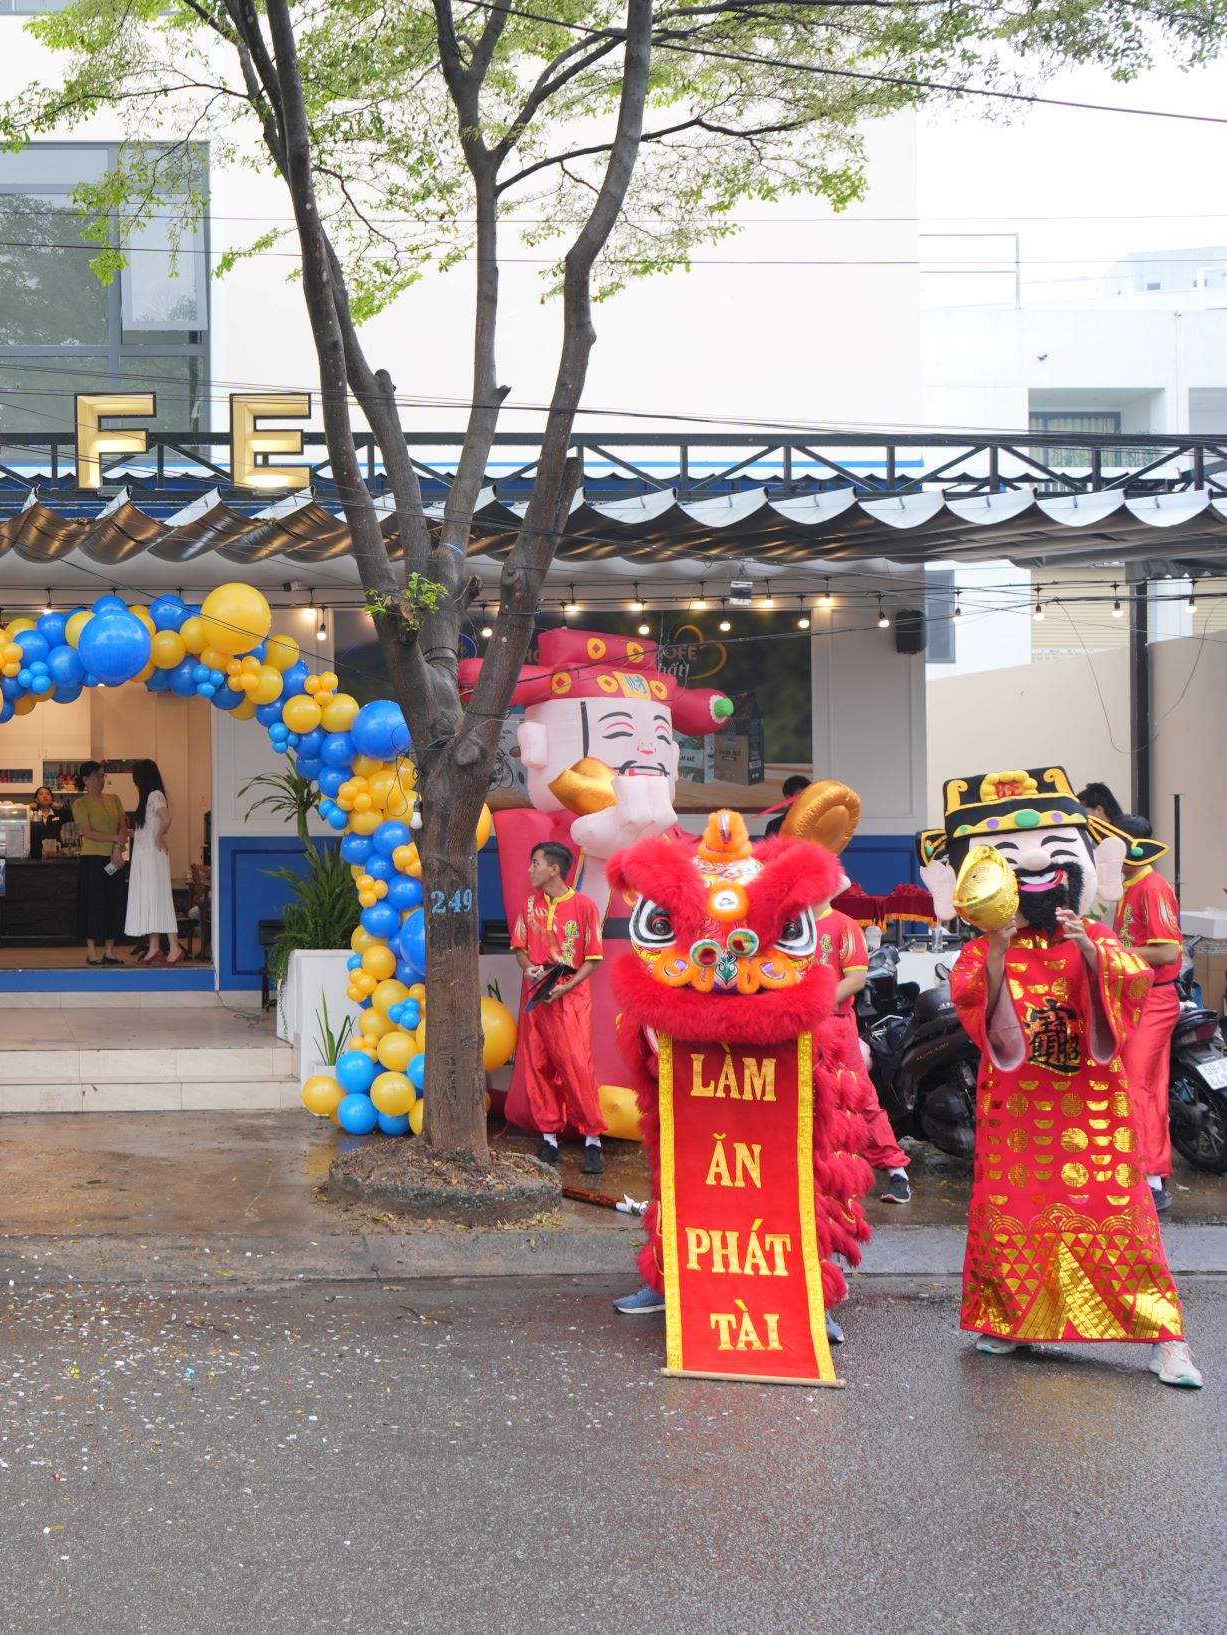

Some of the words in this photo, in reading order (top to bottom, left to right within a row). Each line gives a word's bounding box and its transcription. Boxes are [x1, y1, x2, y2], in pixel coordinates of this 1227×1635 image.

[430, 887, 473, 914] 249
[690, 1042, 777, 1102] LÀM
[705, 1132, 762, 1189] ĂN
[685, 1218, 792, 1277] PHÁT
[710, 1299, 783, 1351] TÀI
